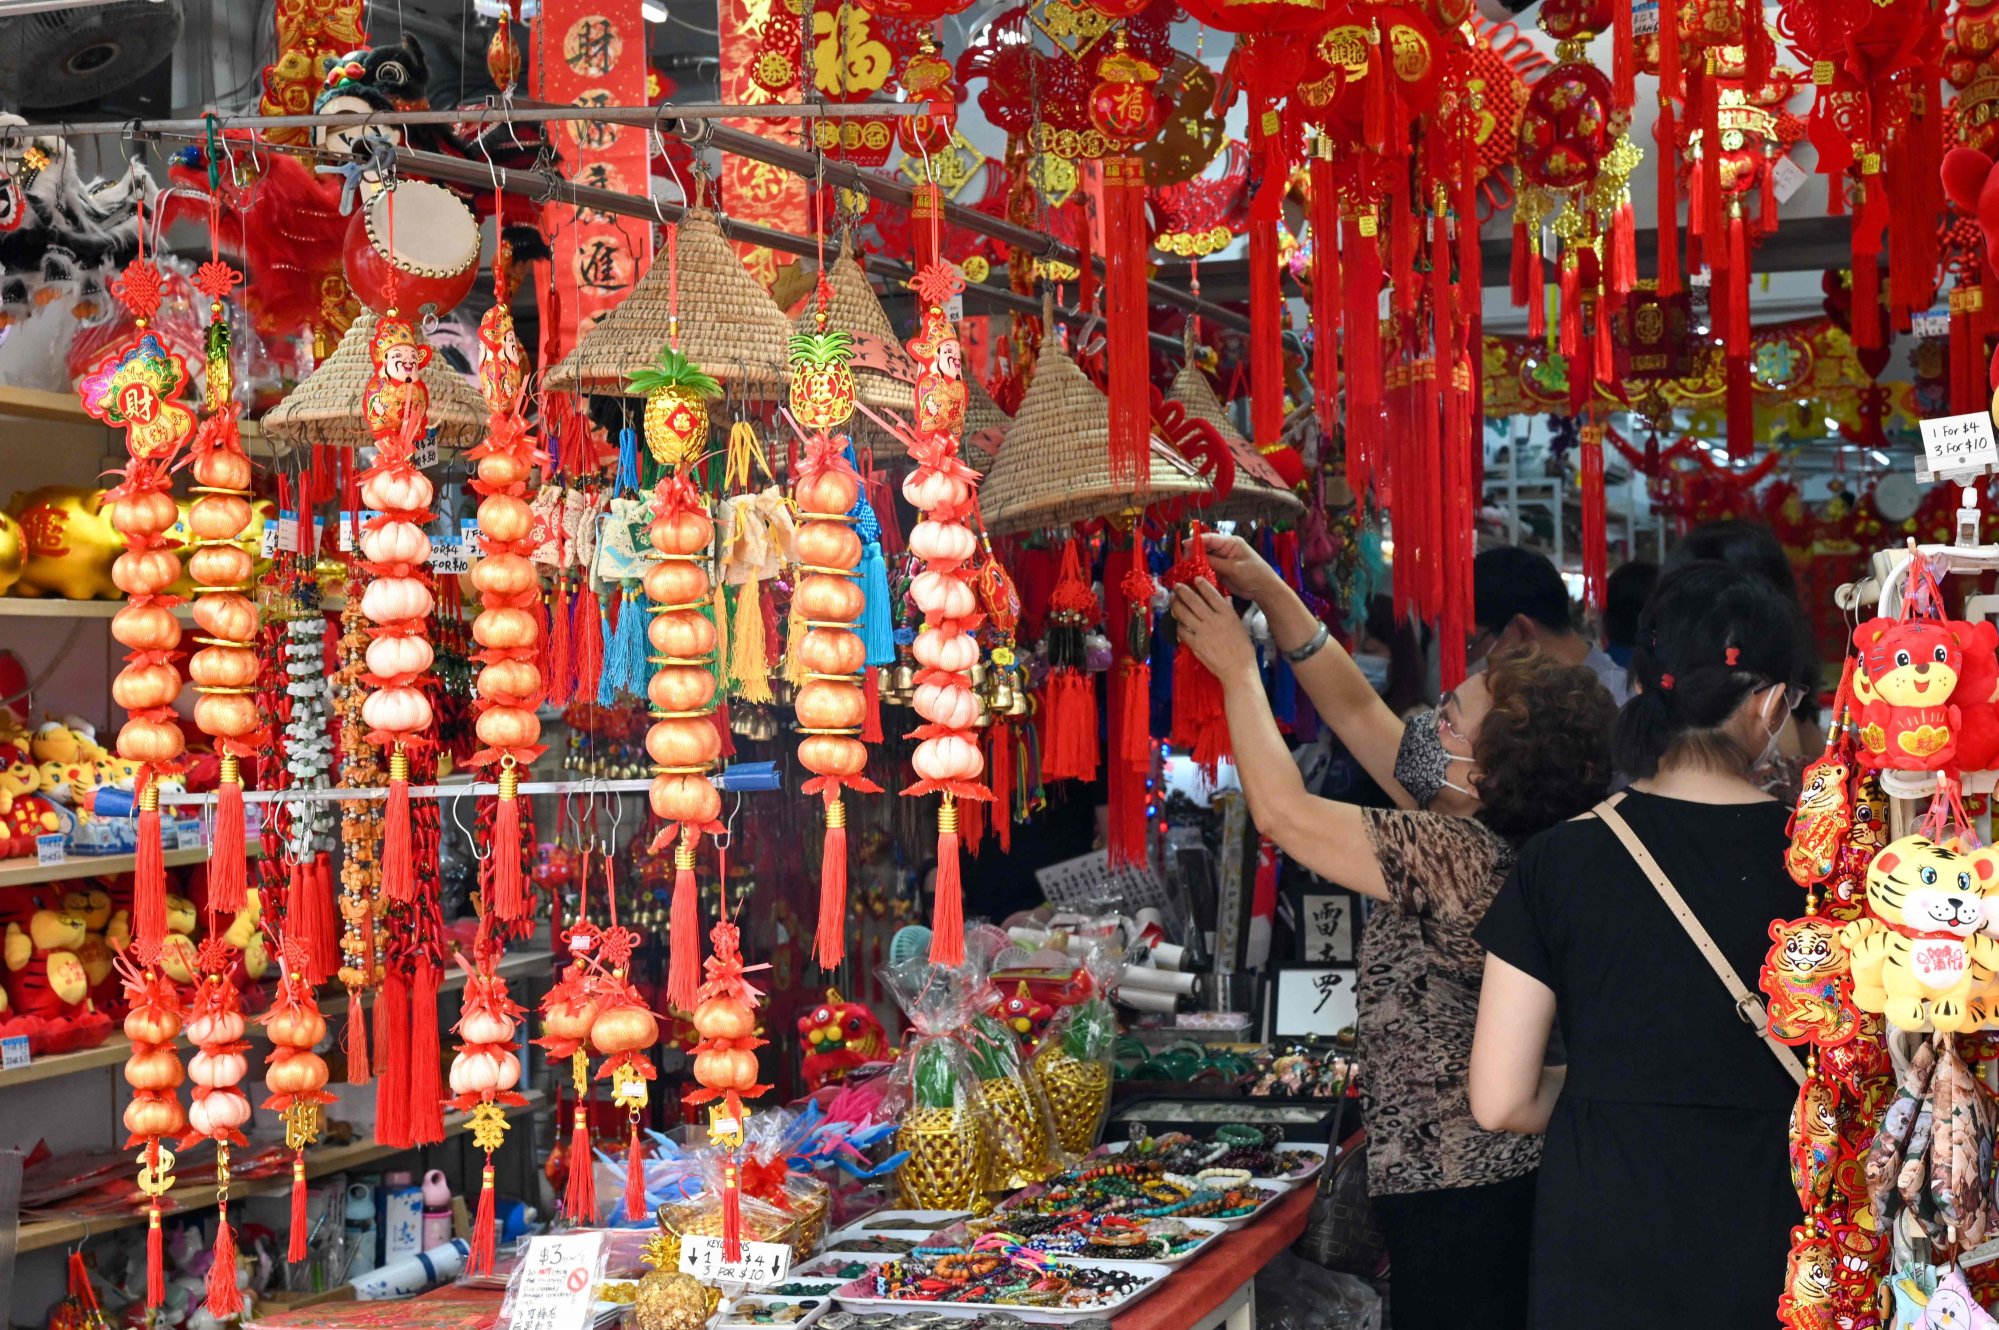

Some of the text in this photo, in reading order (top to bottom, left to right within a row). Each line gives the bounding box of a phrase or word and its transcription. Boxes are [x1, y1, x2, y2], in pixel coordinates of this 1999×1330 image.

[809, 4, 892, 95] 福
[1112, 84, 1144, 121] 福
[125, 385, 154, 422] 財
[1933, 422, 1980, 438] 1 For $4
[1934, 437, 1988, 456] 3 For $10
[430, 544, 447, 556] OR
[1833, 1046, 1855, 1071] 虎
[706, 1239, 751, 1252] KEYCNS
[539, 1243, 562, 1266] $3
[704, 1251, 711, 1264] 1
[539, 1267, 552, 1275] NOT
[703, 1265, 711, 1276] 3
[718, 1267, 735, 1278] FOR
